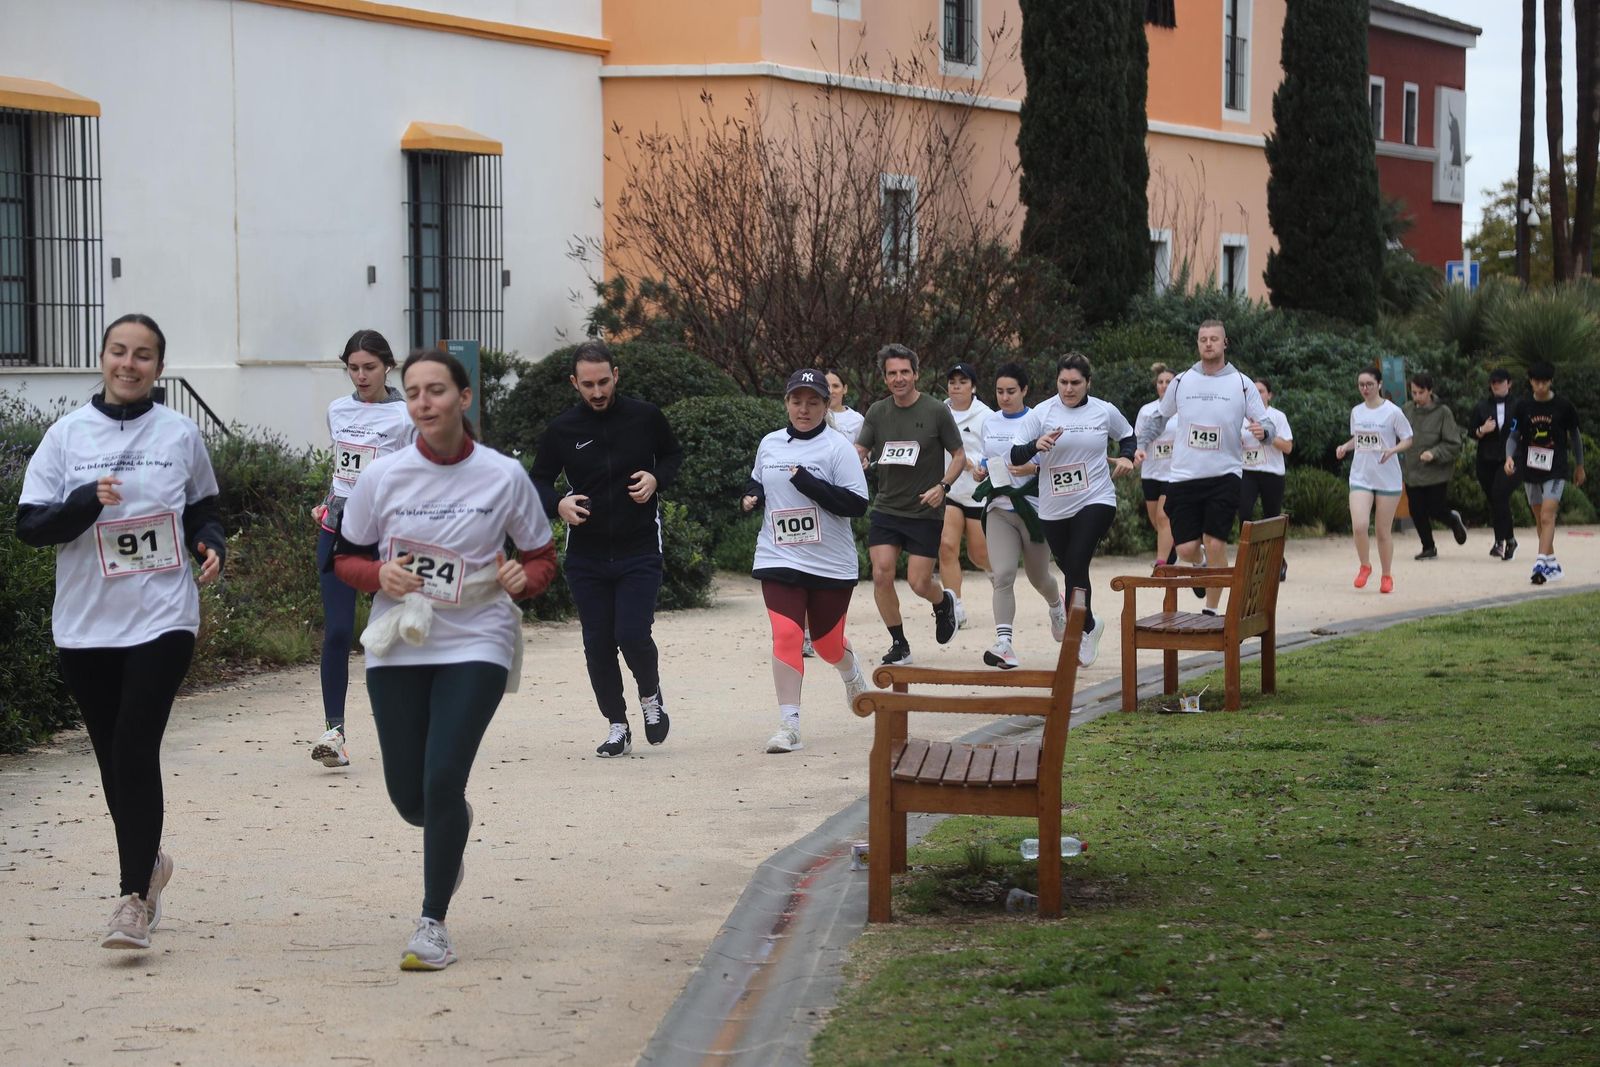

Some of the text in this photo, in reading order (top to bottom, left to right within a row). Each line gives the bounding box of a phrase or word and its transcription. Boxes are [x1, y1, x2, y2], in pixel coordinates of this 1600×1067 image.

[1192, 430, 1218, 442] 149
[886, 447, 914, 457] 301
[1156, 444, 1174, 454] 12
[1246, 450, 1259, 460] 27
[341, 451, 361, 469] 31
[1053, 470, 1083, 485] 231
[777, 516, 815, 533] 100
[117, 529, 158, 555] 91
